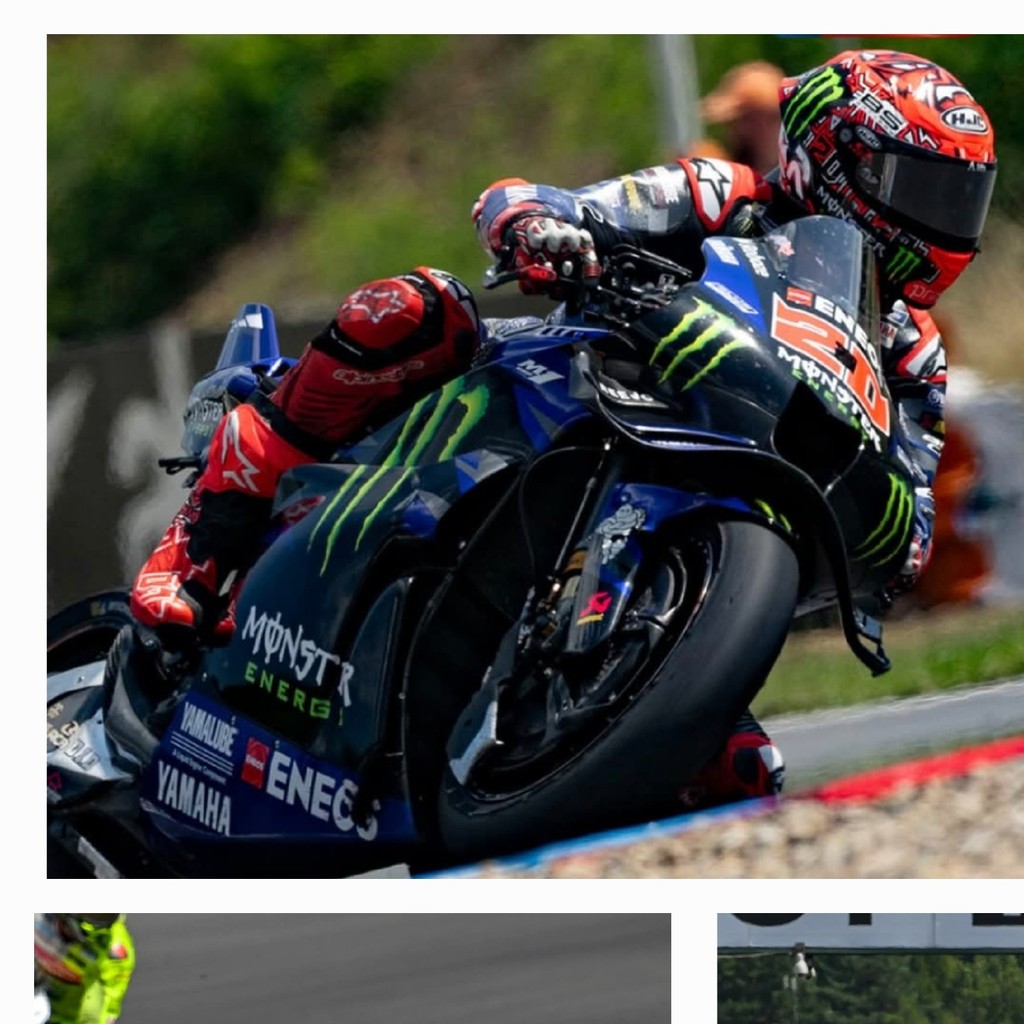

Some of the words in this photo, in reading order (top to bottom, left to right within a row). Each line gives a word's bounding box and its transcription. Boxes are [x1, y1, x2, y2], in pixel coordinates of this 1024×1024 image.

[771, 291, 891, 438] 20
[813, 294, 886, 380] ENEO
[241, 604, 355, 709] MONSTR
[244, 660, 345, 727] ENERG
[179, 701, 239, 758] YAMALUBE
[157, 759, 232, 837] YAMAHA
